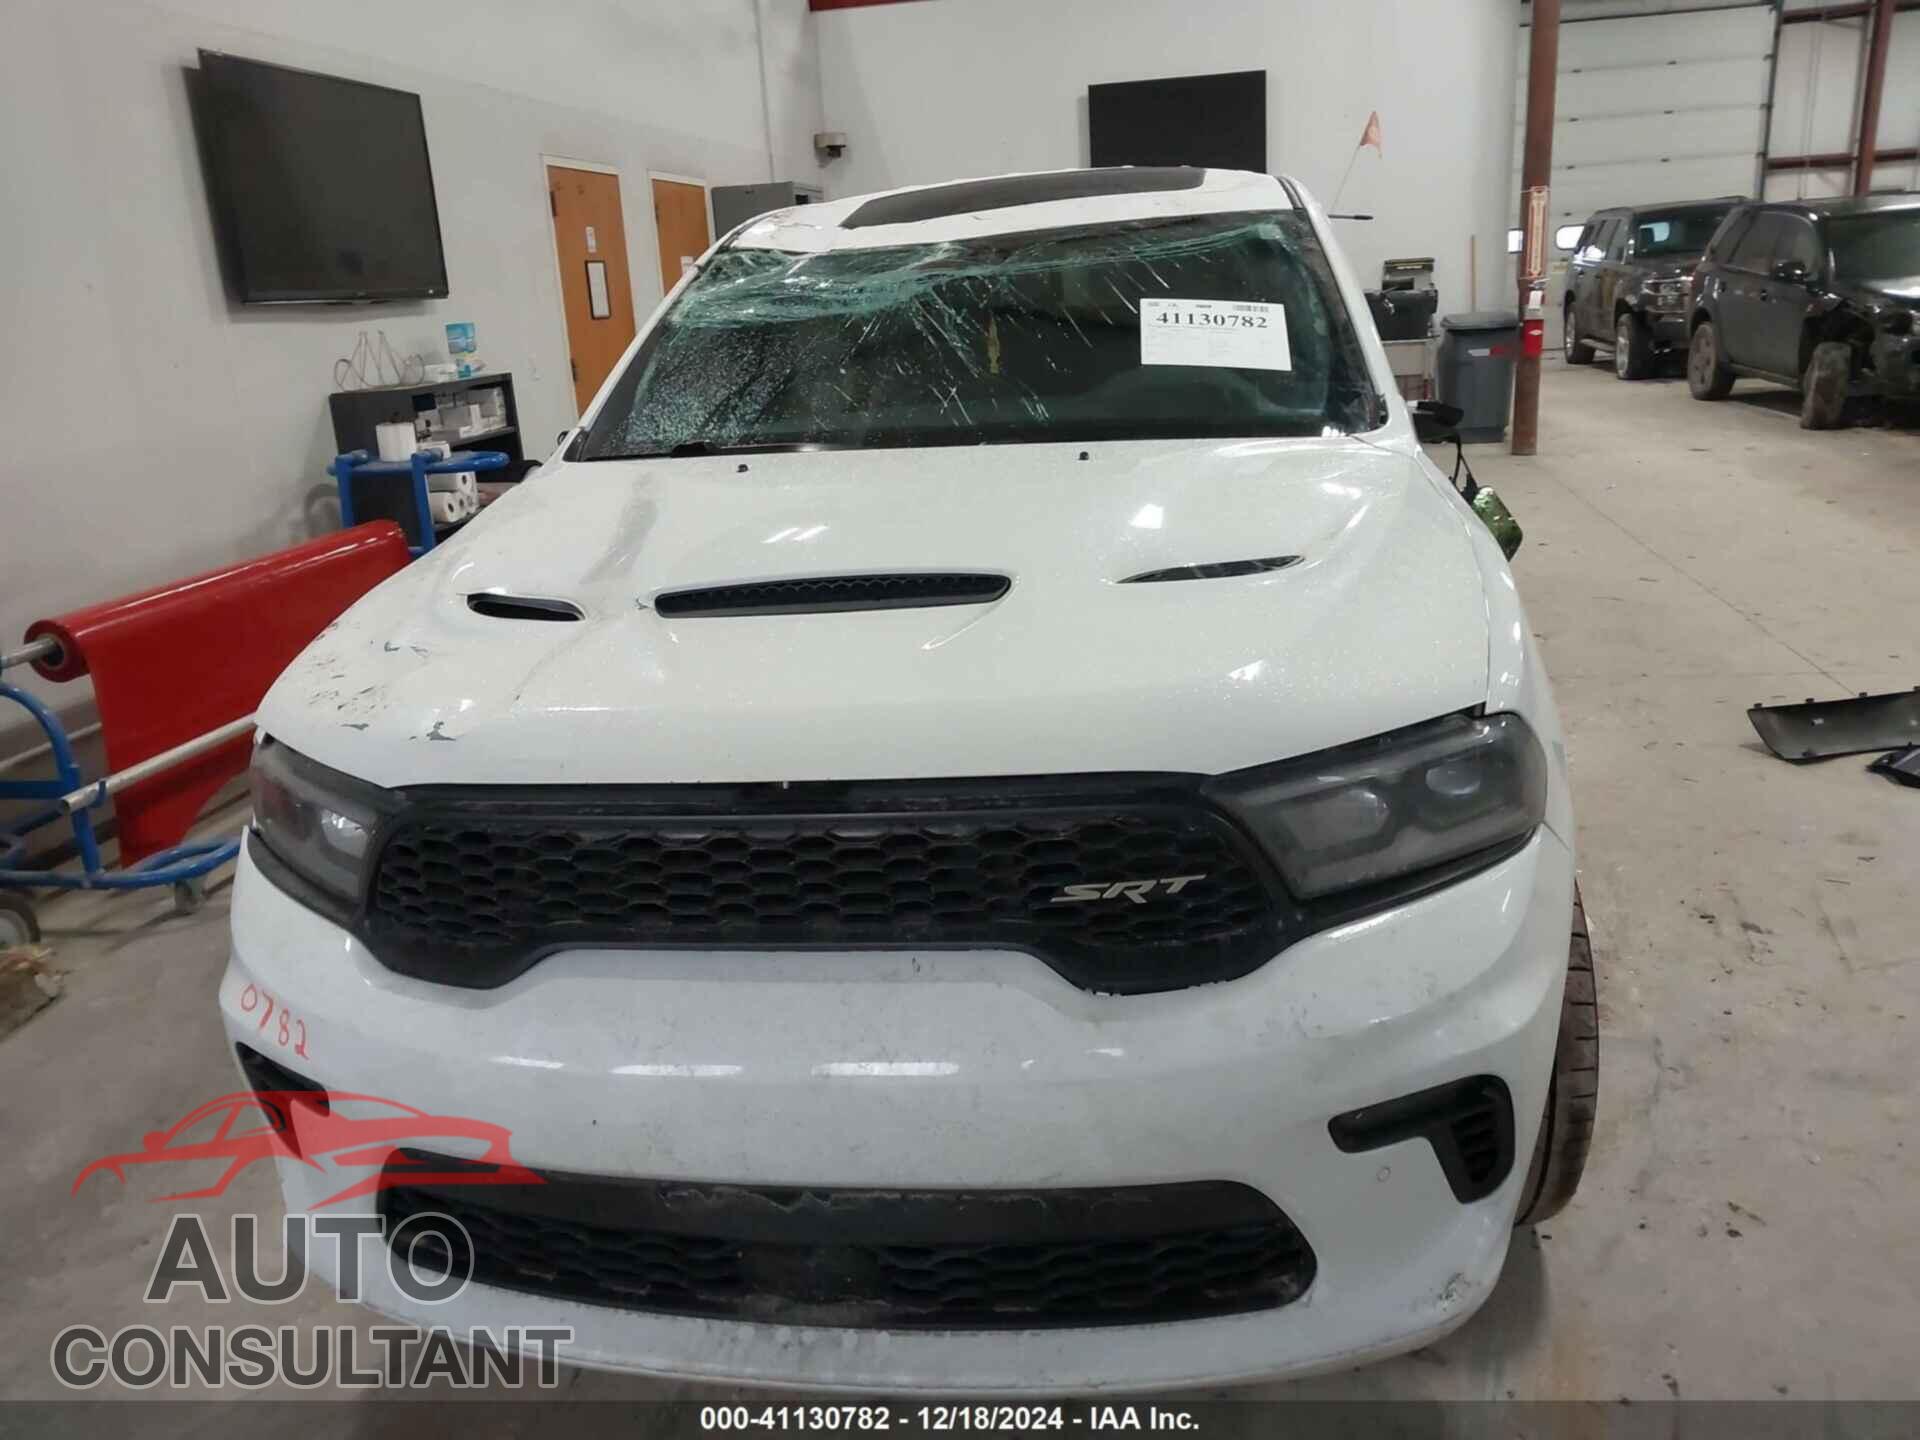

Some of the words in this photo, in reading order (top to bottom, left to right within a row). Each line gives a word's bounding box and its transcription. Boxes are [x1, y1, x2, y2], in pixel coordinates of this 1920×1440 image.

[1156, 312, 1268, 329] 41130782
[1049, 873, 1207, 904] SRT
[241, 983, 309, 1060] 0782
